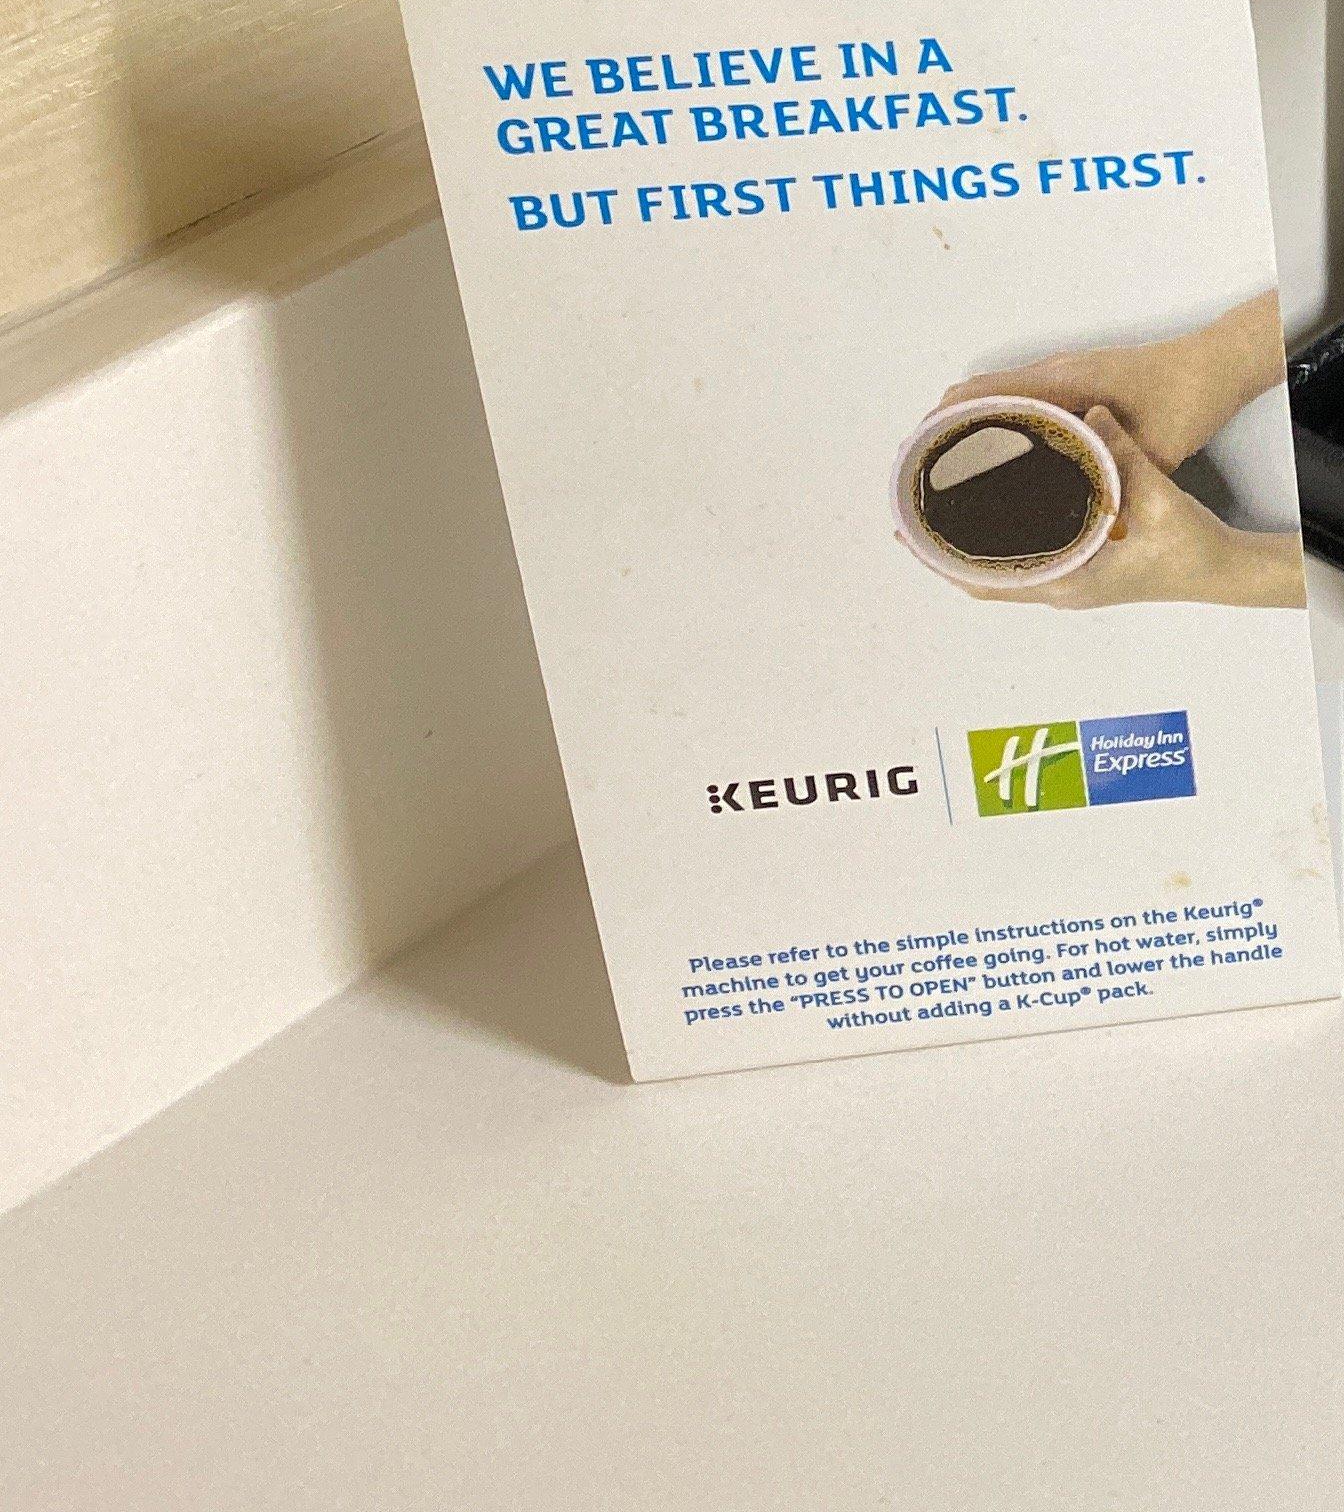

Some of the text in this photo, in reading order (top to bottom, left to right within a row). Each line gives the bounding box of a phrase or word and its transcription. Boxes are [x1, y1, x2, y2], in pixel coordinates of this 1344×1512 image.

[484, 38, 953, 100] WE BELIEVE IN A
[497, 87, 1029, 155] GREAT BREAKFAST.
[510, 151, 1206, 231] BUT FIRST THINGS FIRST.
[1090, 730, 1183, 752] Holiday Inn
[1093, 746, 1189, 776] Express
[706, 766, 919, 814] KEURIG
[682, 921, 1279, 999] machine to get your coffee going. For hot water, simply
[688, 952, 762, 974] Please
[768, 944, 820, 965] refer
[826, 942, 848, 959] to
[853, 936, 890, 956] the
[896, 929, 969, 951] simple
[975, 916, 1105, 943] instructions
[1110, 913, 1136, 930] on
[1142, 907, 1178, 925] the
[684, 1001, 743, 1025] press
[749, 993, 786, 1016] the
[875, 981, 904, 1001] TO
[982, 968, 1056, 990] button
[1062, 962, 1101, 981] and
[1107, 956, 1165, 977] lower
[1170, 949, 1205, 969] the
[1210, 944, 1283, 966] handle
[826, 1007, 912, 1029] without
[918, 998, 992, 1022] adding
[998, 997, 1012, 1011] a
[1097, 981, 1154, 1003] pack.
